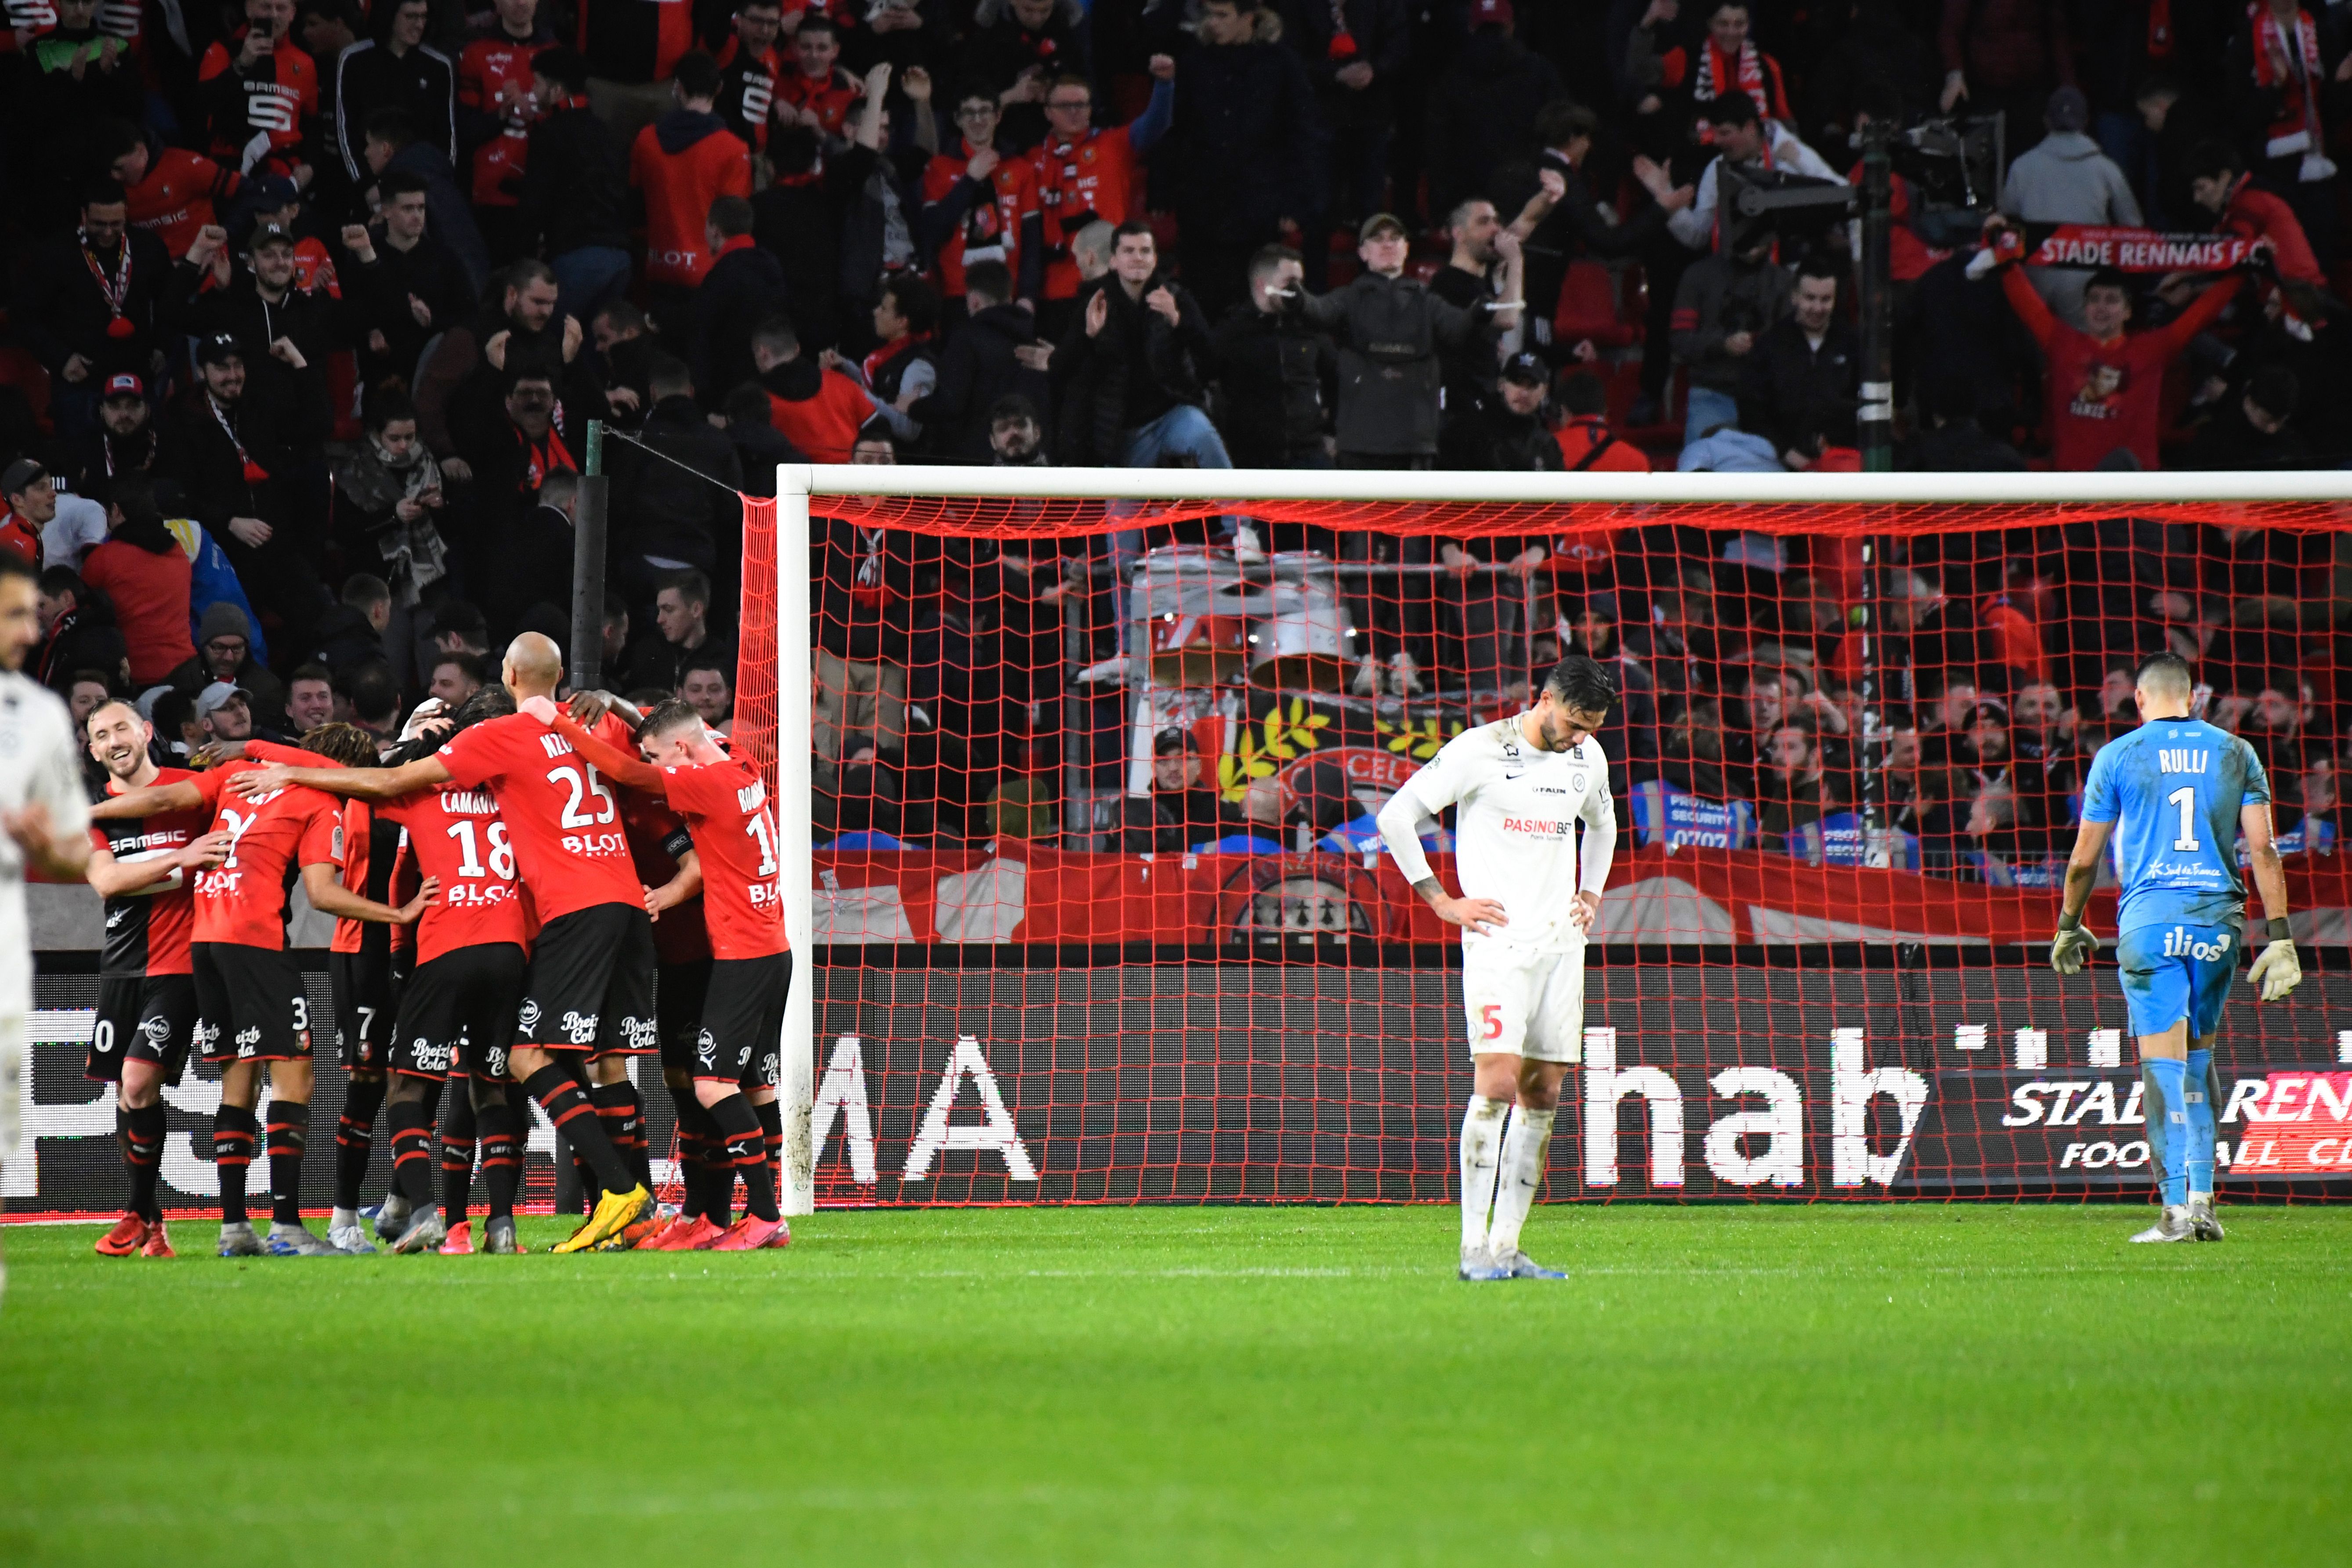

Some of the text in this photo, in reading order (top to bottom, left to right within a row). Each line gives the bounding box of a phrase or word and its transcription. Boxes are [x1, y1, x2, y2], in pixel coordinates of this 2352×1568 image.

[132, 208, 189, 230] AMSIC
[2042, 237, 2114, 265] STADE
[2120, 240, 2225, 267] RENNAIS
[539, 733, 573, 759] NZO
[1347, 754, 1401, 784] CEL
[2158, 748, 2208, 774] RULLI
[546, 762, 615, 830] 25
[1670, 795, 1729, 812] PROT
[1671, 809, 1733, 827] SECURITY
[2167, 786, 2200, 852] 1
[109, 829, 187, 853] SAMSIC
[446, 820, 515, 881] 18
[561, 833, 625, 853] BLOT
[2163, 925, 2223, 962] ilios
[357, 1006, 376, 1040] 7
[1483, 1004, 1503, 1040] 5
[416, 1055, 448, 1071] Cola
